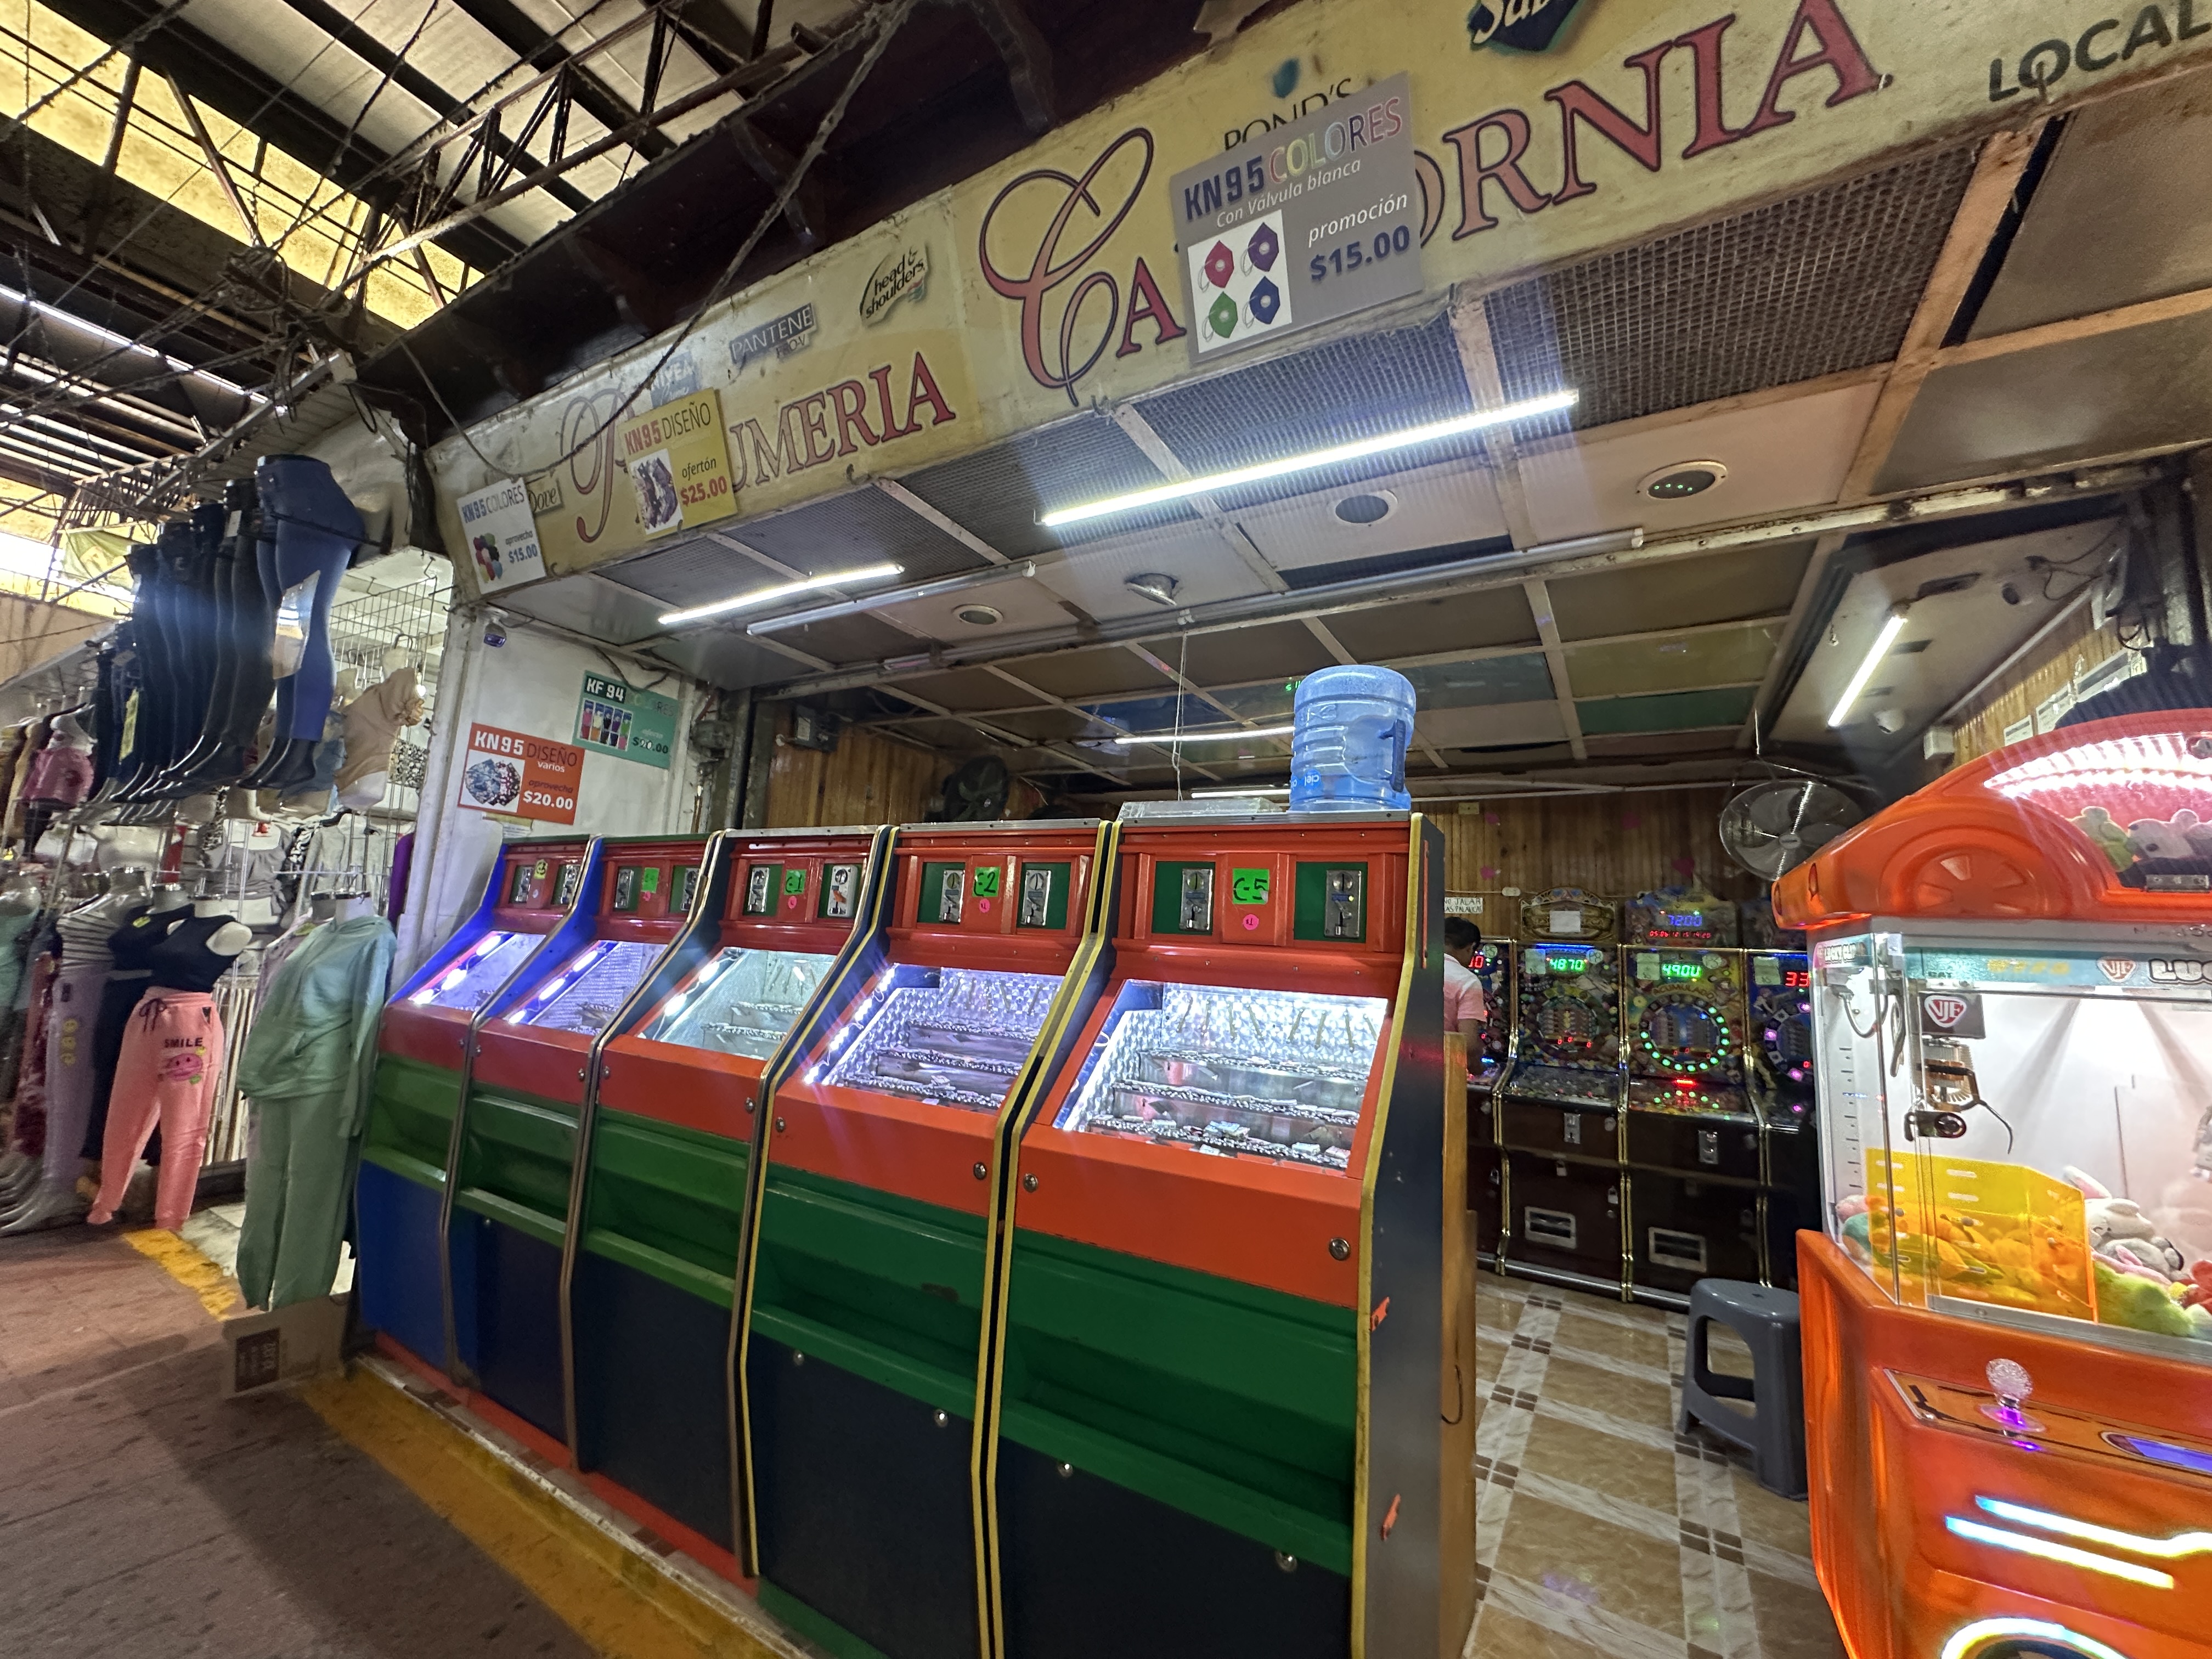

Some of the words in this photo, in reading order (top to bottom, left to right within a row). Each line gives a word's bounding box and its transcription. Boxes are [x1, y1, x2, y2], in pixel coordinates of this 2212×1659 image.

[1988, 0, 2212, 102] LOCAL
[1184, 155, 1266, 222] KN95
[1268, 95, 1403, 186] COLORES
[1216, 205, 1244, 228] Con
[1248, 183, 1302, 216] Válvula
[1307, 158, 1361, 191] blanca
[1308, 193, 1408, 249] promoción
[1309, 224, 1411, 283] $15.00
[874, 253, 905, 296] head
[731, 306, 814, 360] PANTENE
[624, 419, 662, 456] KN95
[662, 400, 712, 440] DISEÑO
[681, 456, 717, 481] ofertón
[461, 499, 487, 523] KN95
[486, 485, 525, 514] COLORES
[528, 488, 557, 513] Dove
[680, 475, 728, 507] $25.00
[508, 543, 538, 564] $15.00
[586, 677, 605, 695] KF
[606, 682, 625, 702] 94
[474, 730, 524, 757] KN95
[526, 742, 578, 768] DISEÑO
[537, 760, 566, 773] varios
[523, 789, 574, 811] $20.00
[528, 778, 574, 794] aprovecha
[1233, 877, 1268, 901] C-5
[1668, 915, 1703, 927] 7200
[1549, 958, 1587, 972] 4870
[164, 1037, 204, 1048] SMILE
